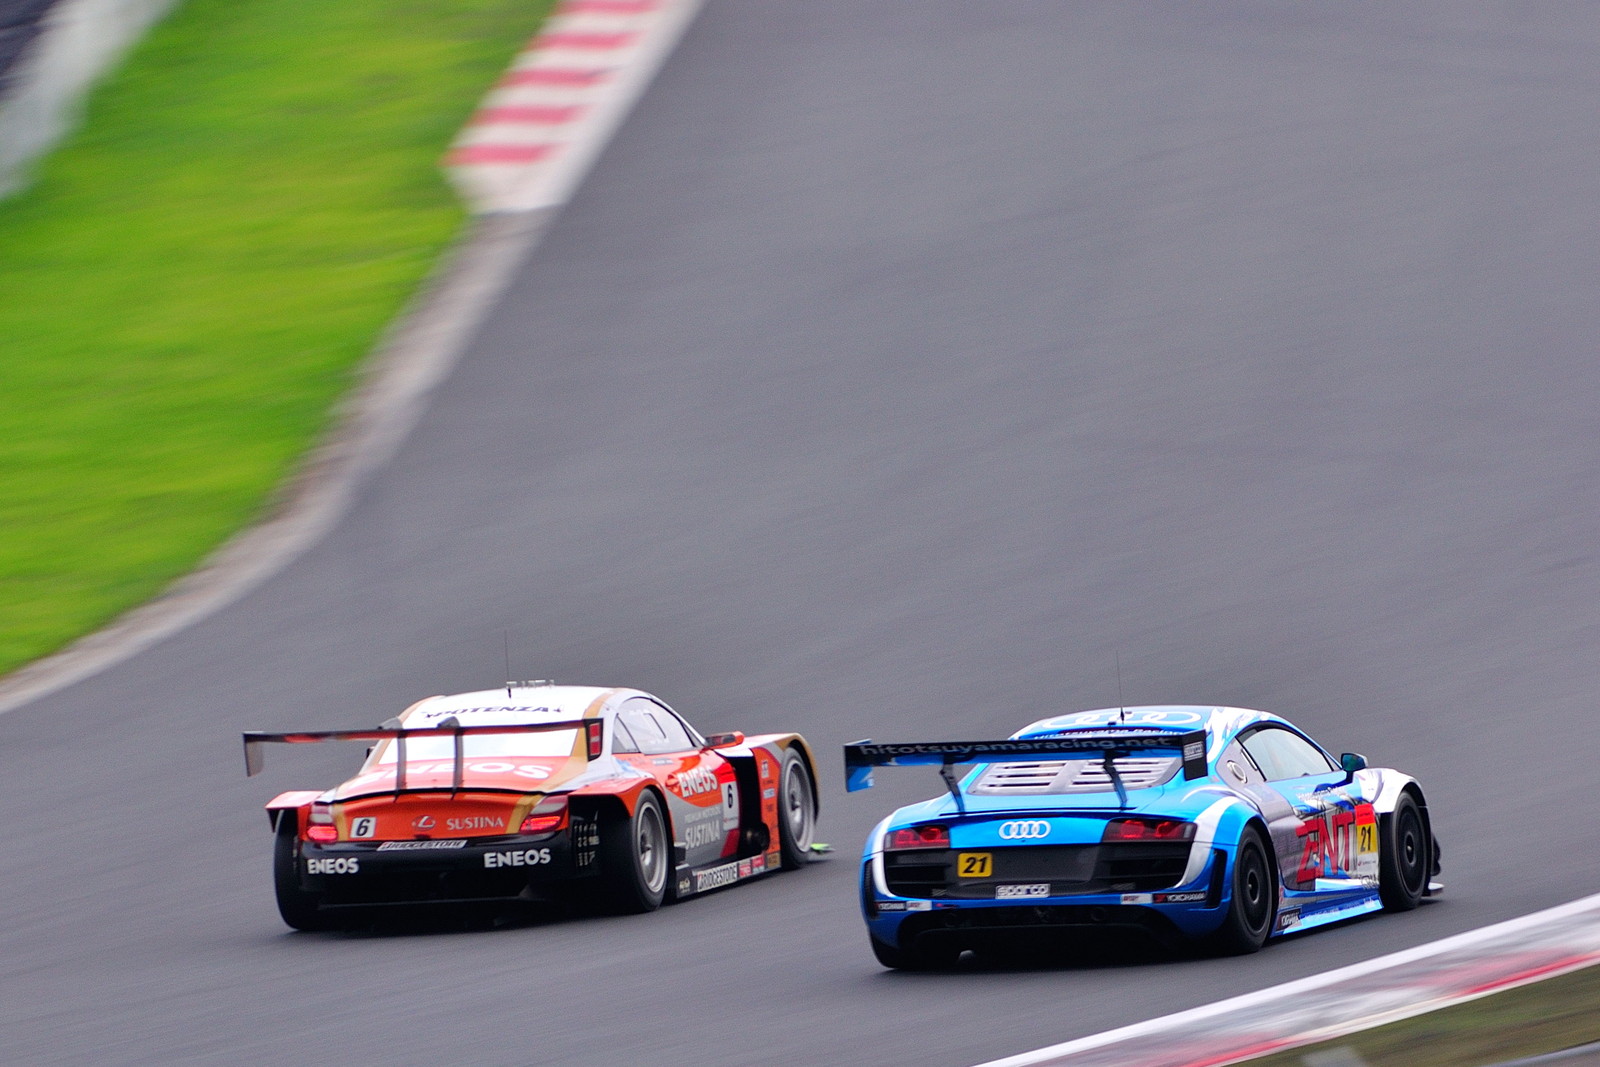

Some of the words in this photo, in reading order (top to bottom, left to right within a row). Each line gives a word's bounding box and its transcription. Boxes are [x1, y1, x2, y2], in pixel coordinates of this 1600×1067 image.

[860, 735, 1173, 757] hitotsuyamaracing.net
[678, 766, 719, 798] ENEOS
[727, 784, 734, 809] 6
[356, 818, 370, 837] 6
[446, 817, 505, 831] SUSTINA
[383, 841, 465, 850] BRIDGESTONE
[684, 821, 721, 850] SUSTINA
[1360, 825, 1371, 852] 21
[307, 857, 360, 875] ENEOS
[484, 848, 552, 869] ENEOS
[963, 856, 988, 874] 21
[698, 863, 738, 891] BRIDGESTONE
[997, 885, 1048, 898] sparco
